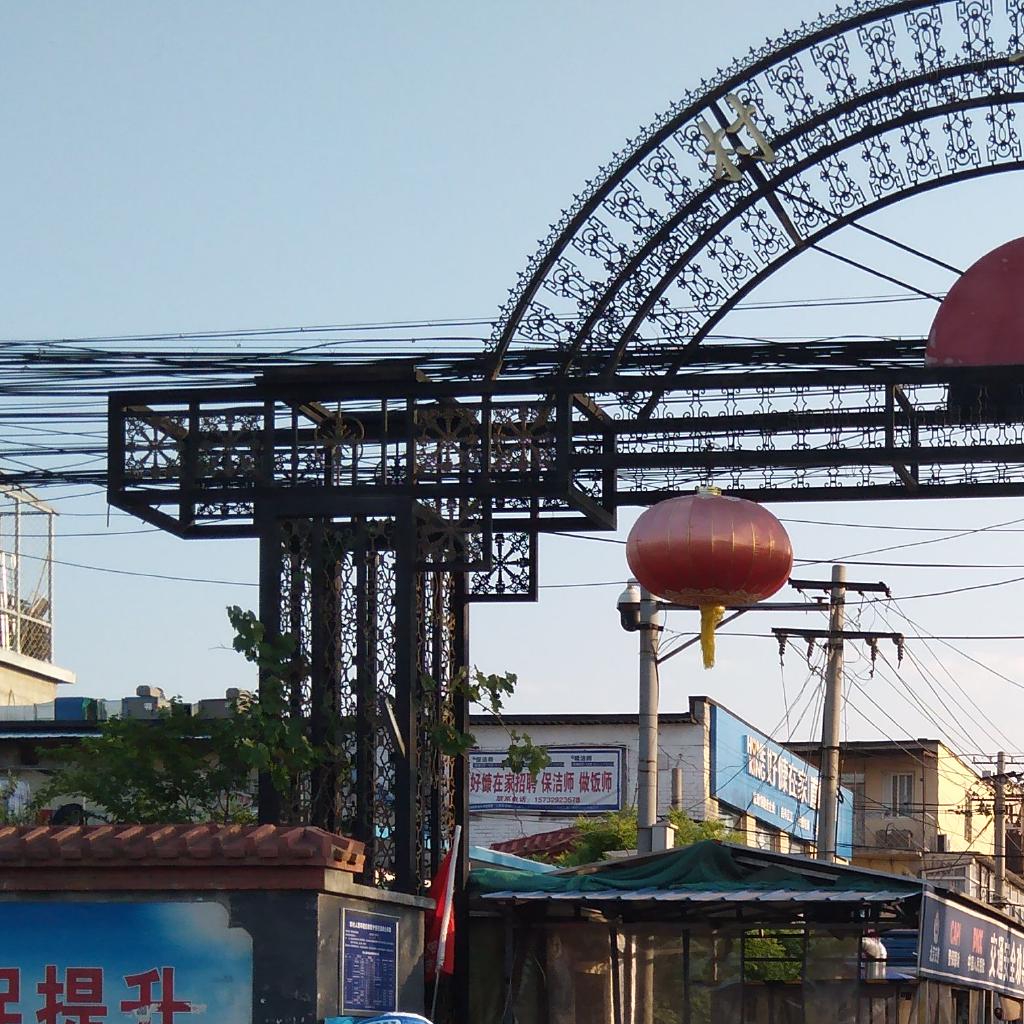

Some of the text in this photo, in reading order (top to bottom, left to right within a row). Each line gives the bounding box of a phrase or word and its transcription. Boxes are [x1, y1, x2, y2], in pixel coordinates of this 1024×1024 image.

[541, 771, 575, 793] 保洁师
[579, 770, 613, 793] 做饭师
